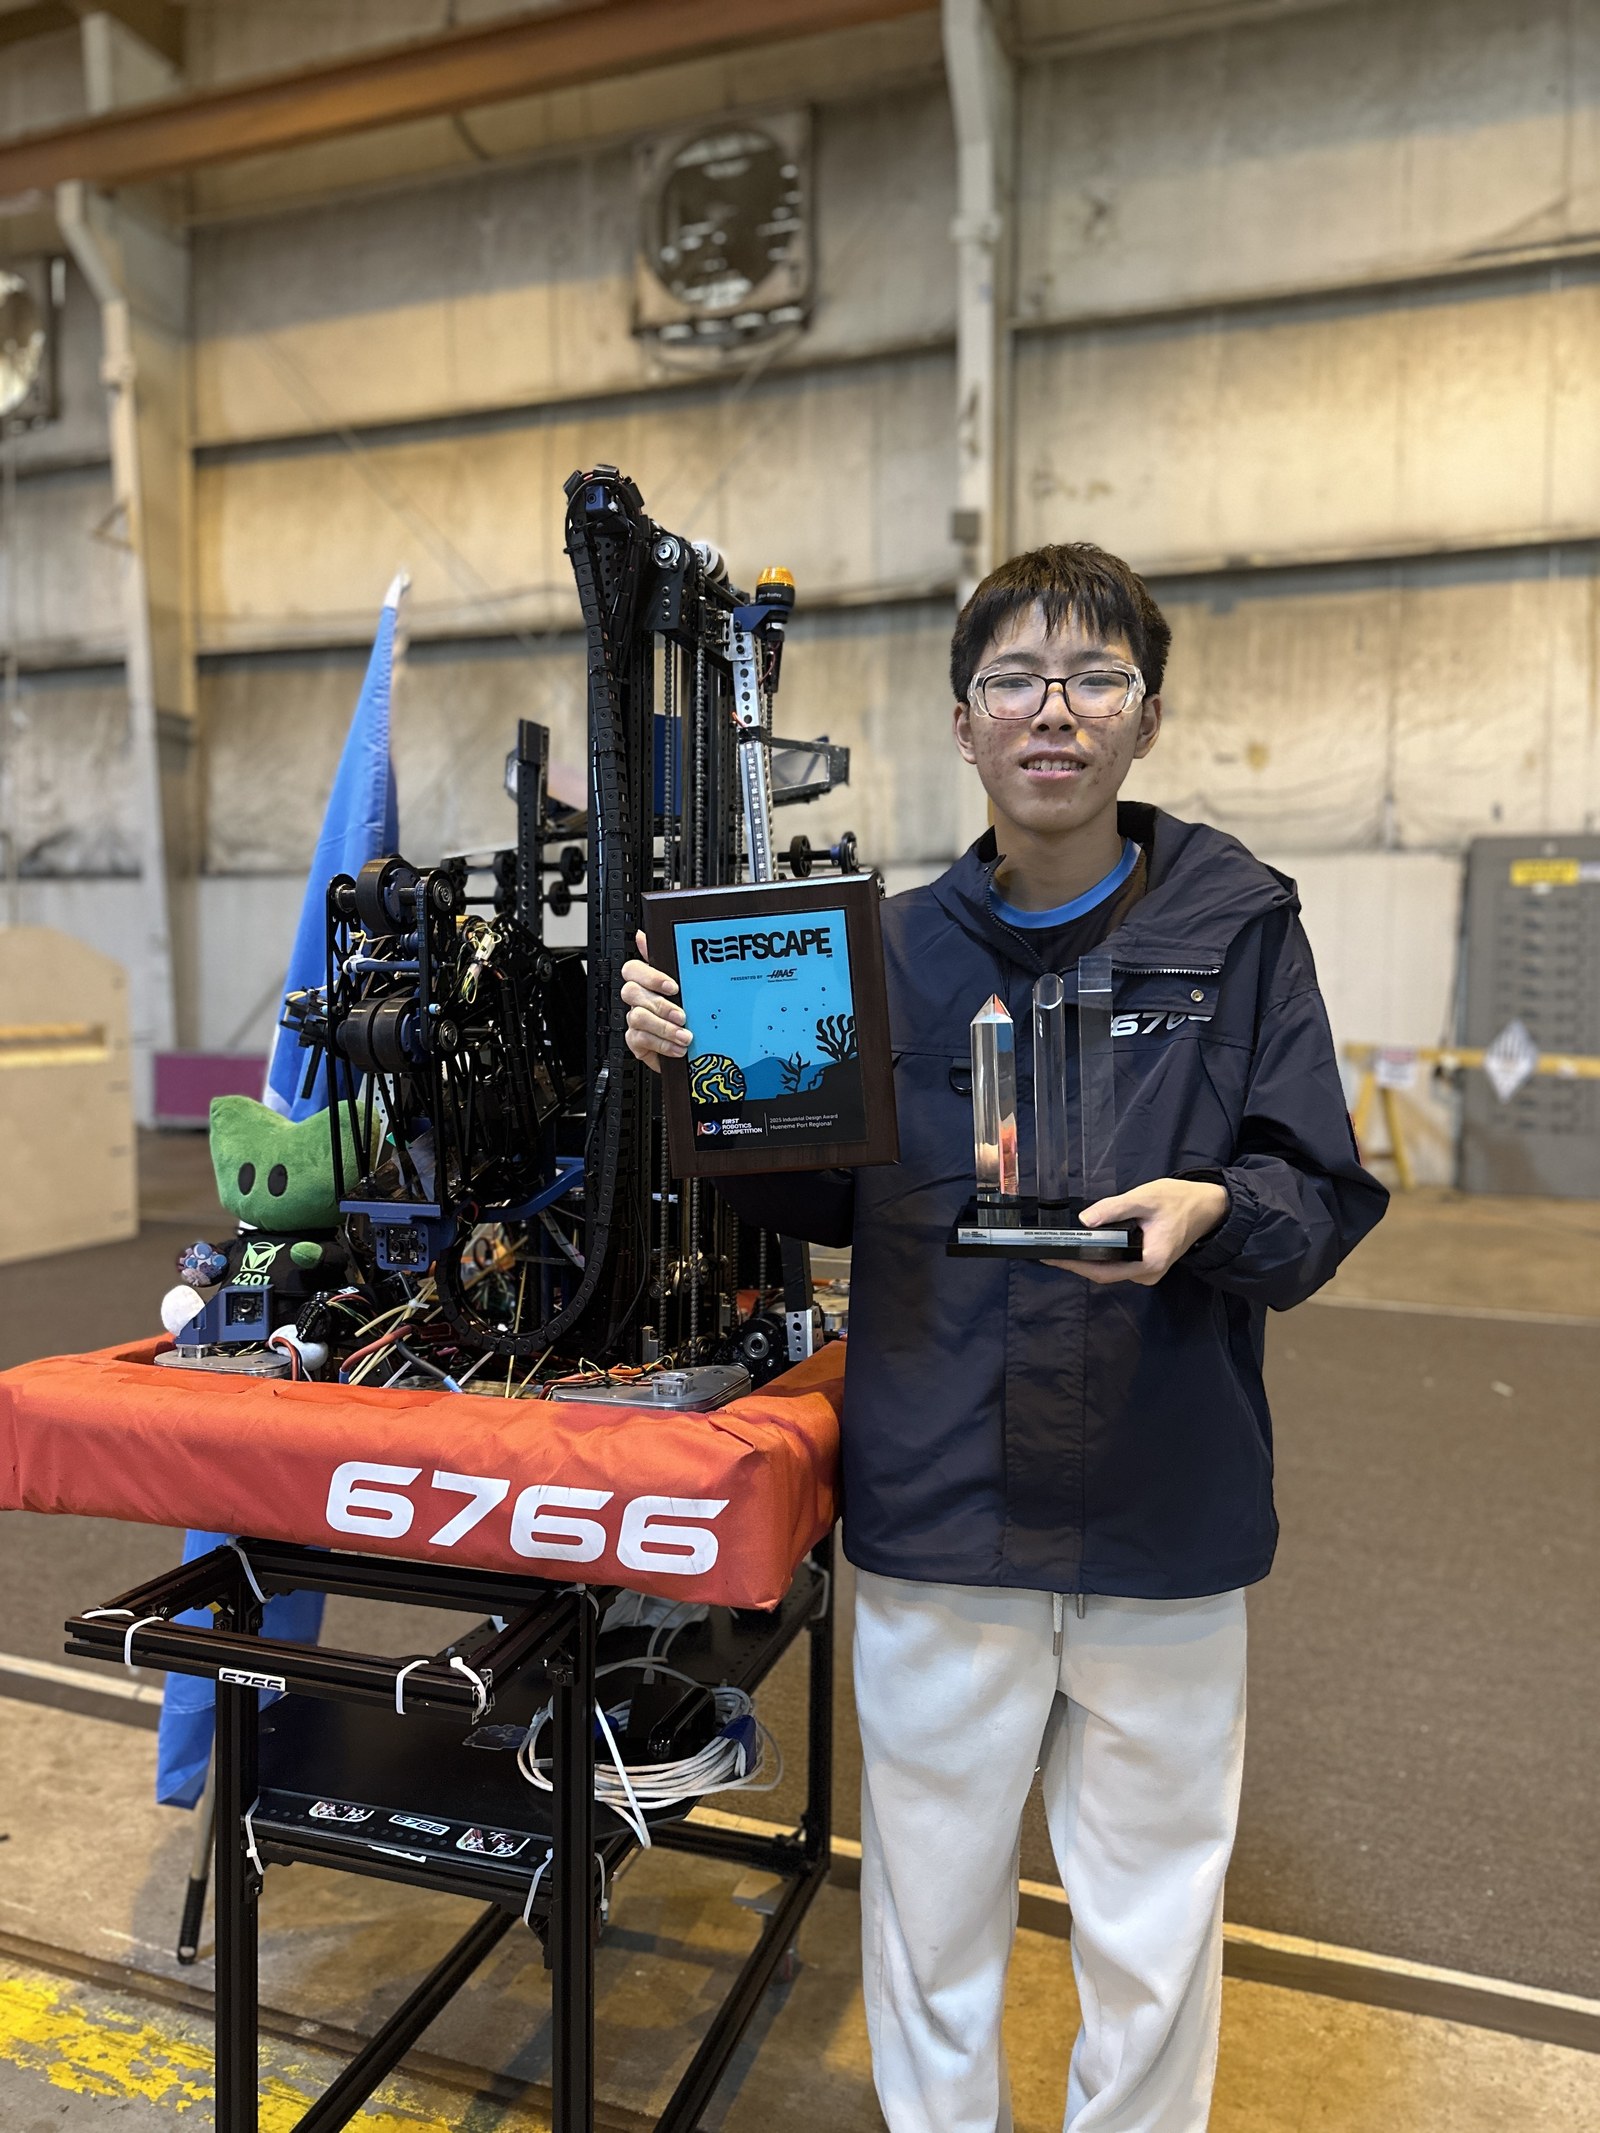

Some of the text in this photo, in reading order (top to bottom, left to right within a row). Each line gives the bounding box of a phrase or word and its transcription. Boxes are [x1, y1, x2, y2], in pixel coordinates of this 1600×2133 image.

[691, 927, 832, 965] REEFSCAPE
[766, 968, 798, 979] HAAS
[722, 1122, 752, 1130] ROBOTICS
[809, 1120, 832, 1128] Regional
[723, 1127, 763, 1136] COMPETITION
[232, 1273, 270, 1286] 4201
[325, 1460, 730, 1576] 6766
[392, 1815, 448, 1833] 6766
